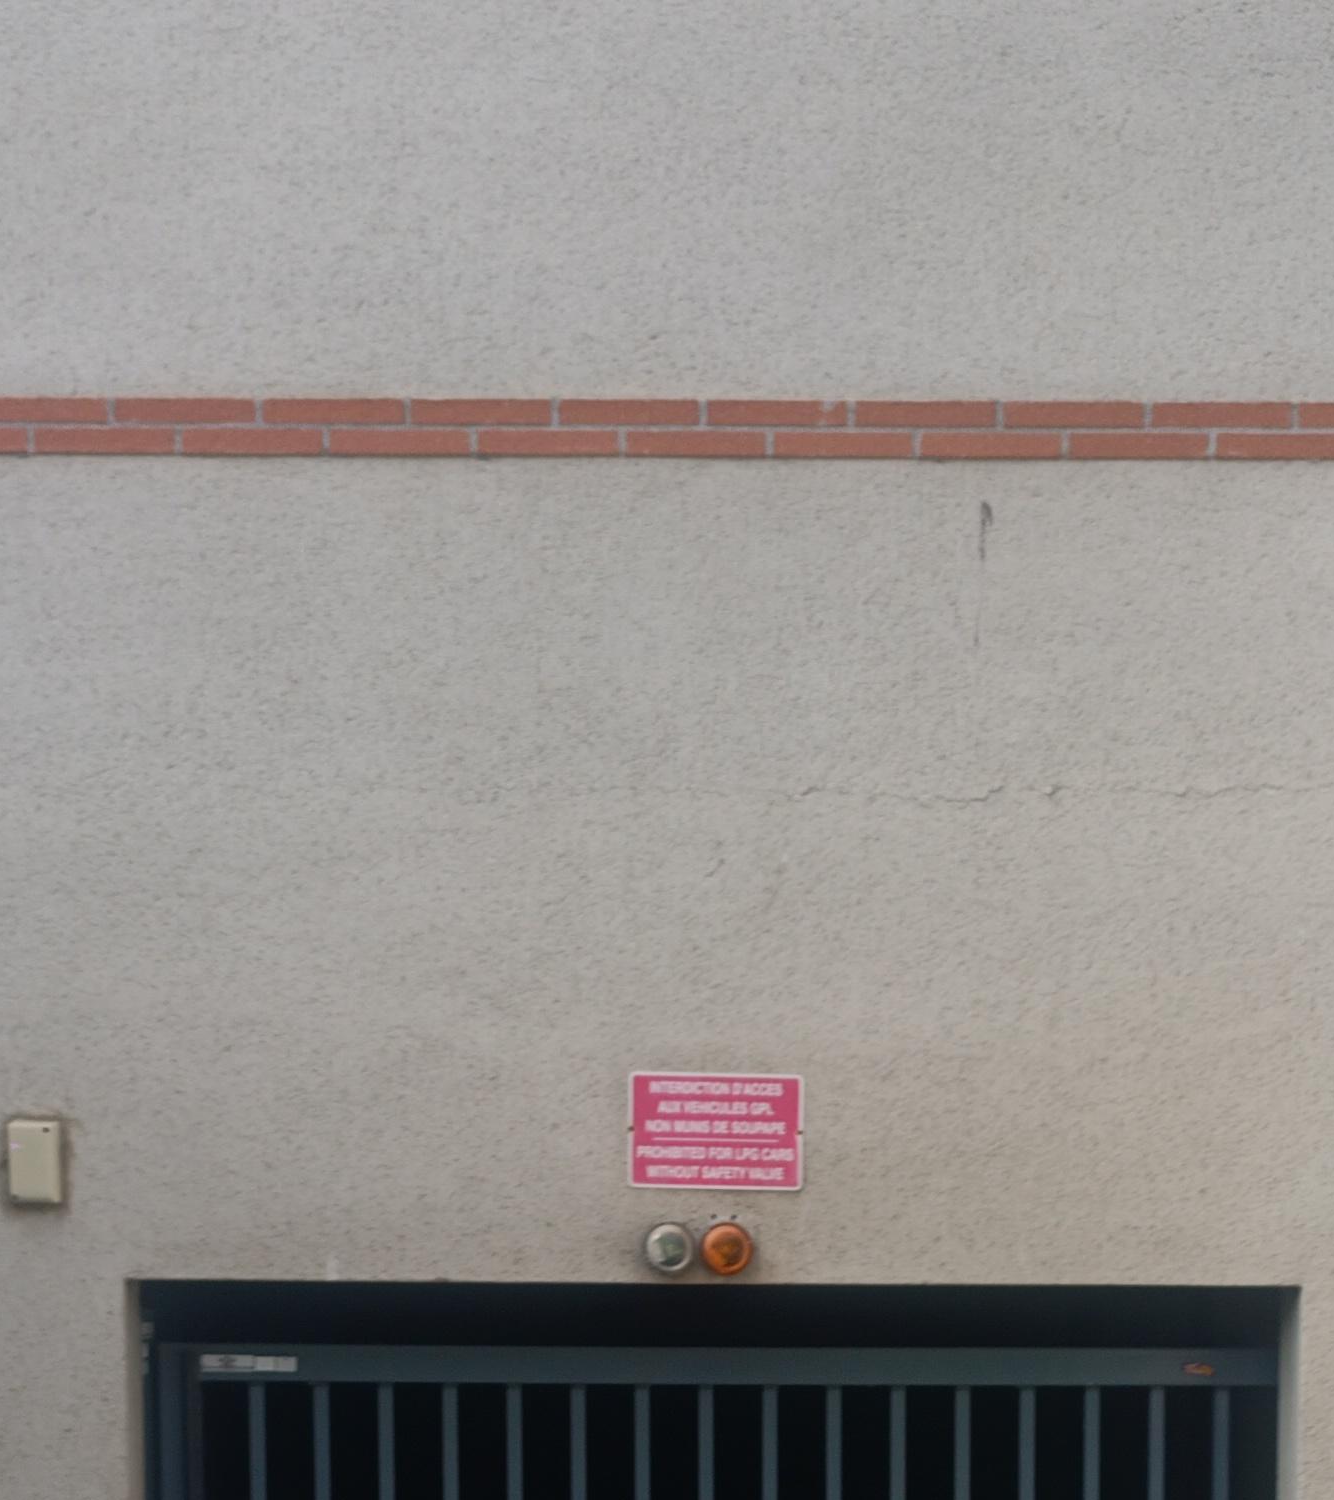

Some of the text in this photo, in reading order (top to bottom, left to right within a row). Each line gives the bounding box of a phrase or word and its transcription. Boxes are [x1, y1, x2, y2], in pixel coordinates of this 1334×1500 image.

[657, 1100, 681, 1114] AUX
[749, 1102, 775, 1116] GPL
[645, 1120, 786, 1135] NON MUNIS DE SOUPAPE
[636, 1145, 795, 1162] PROHIBITED FOR LPG CARS
[646, 1165, 785, 1181] WITHOUT SAFETY VALVE
